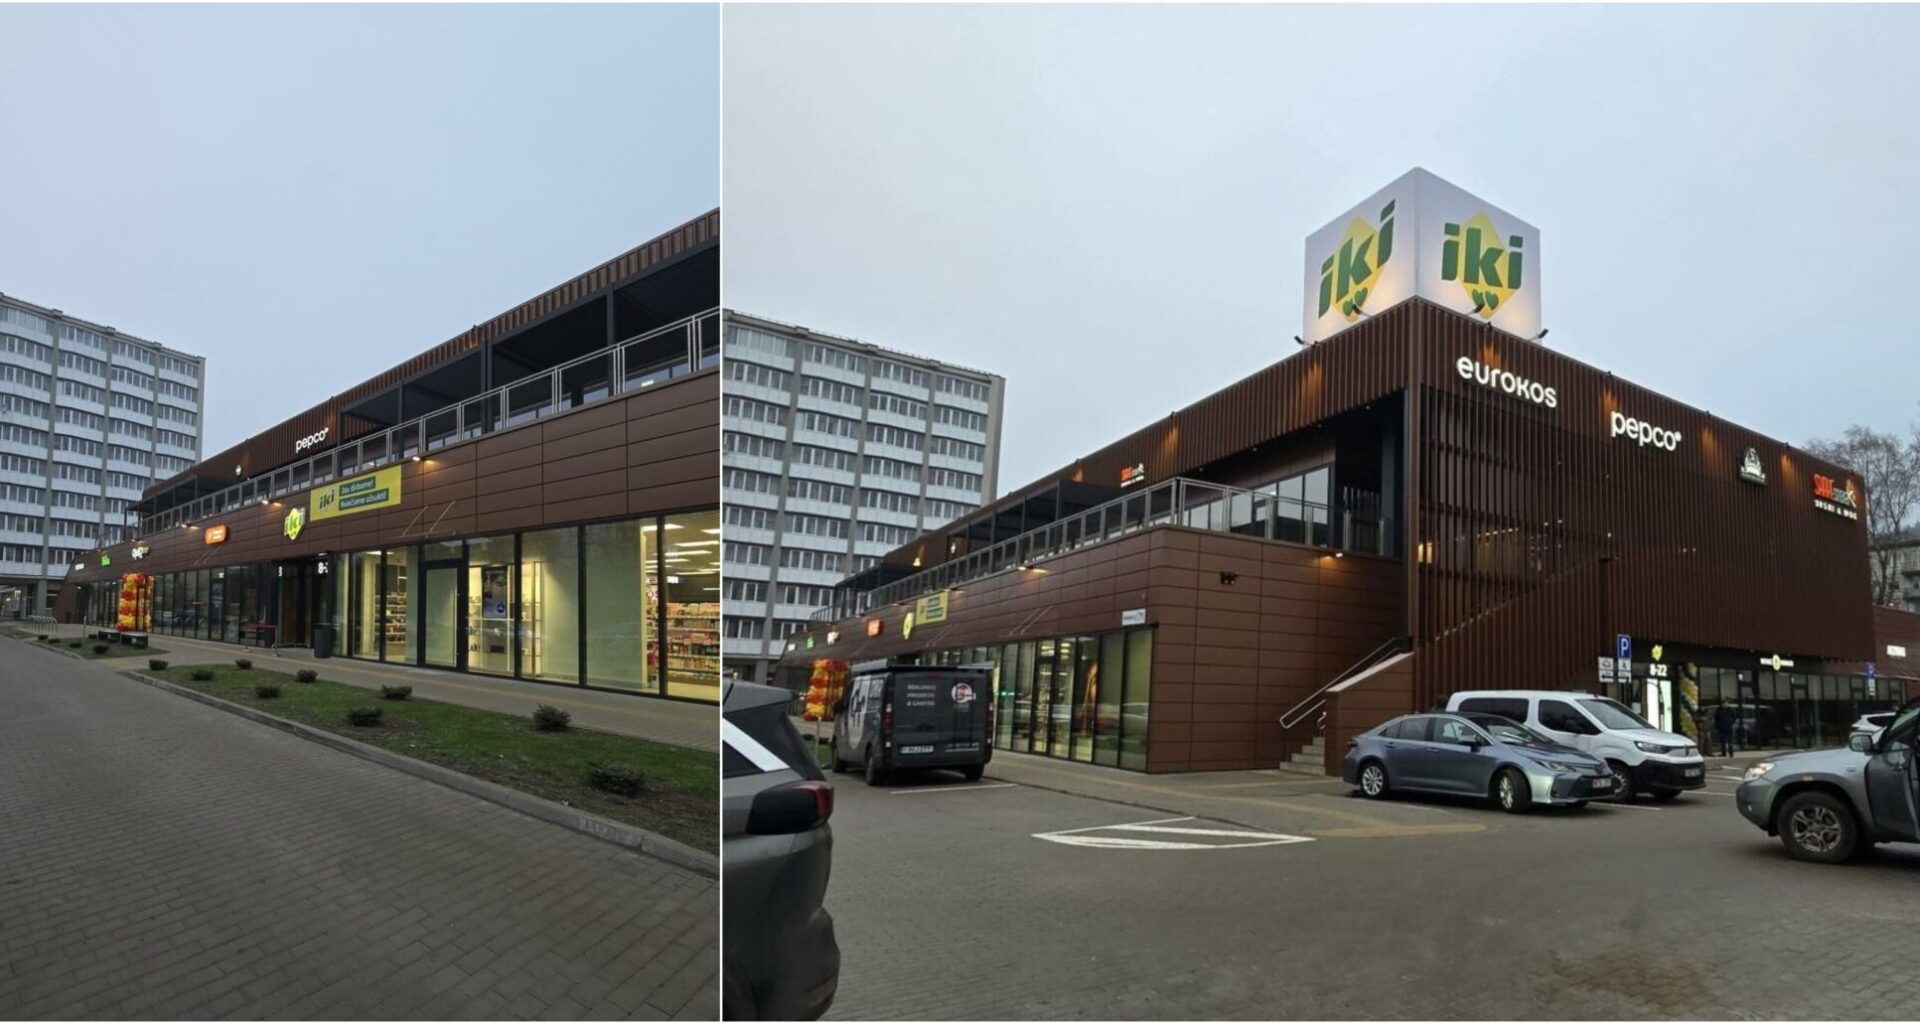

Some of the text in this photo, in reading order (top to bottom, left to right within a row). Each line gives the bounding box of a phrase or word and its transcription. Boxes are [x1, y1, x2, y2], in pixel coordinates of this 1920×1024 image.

[1319, 198, 1395, 319] iki
[1441, 222, 1524, 290] iki
[1610, 410, 1678, 452] pepco
[319, 489, 335, 509] iki
[1621, 638, 1629, 657] P
